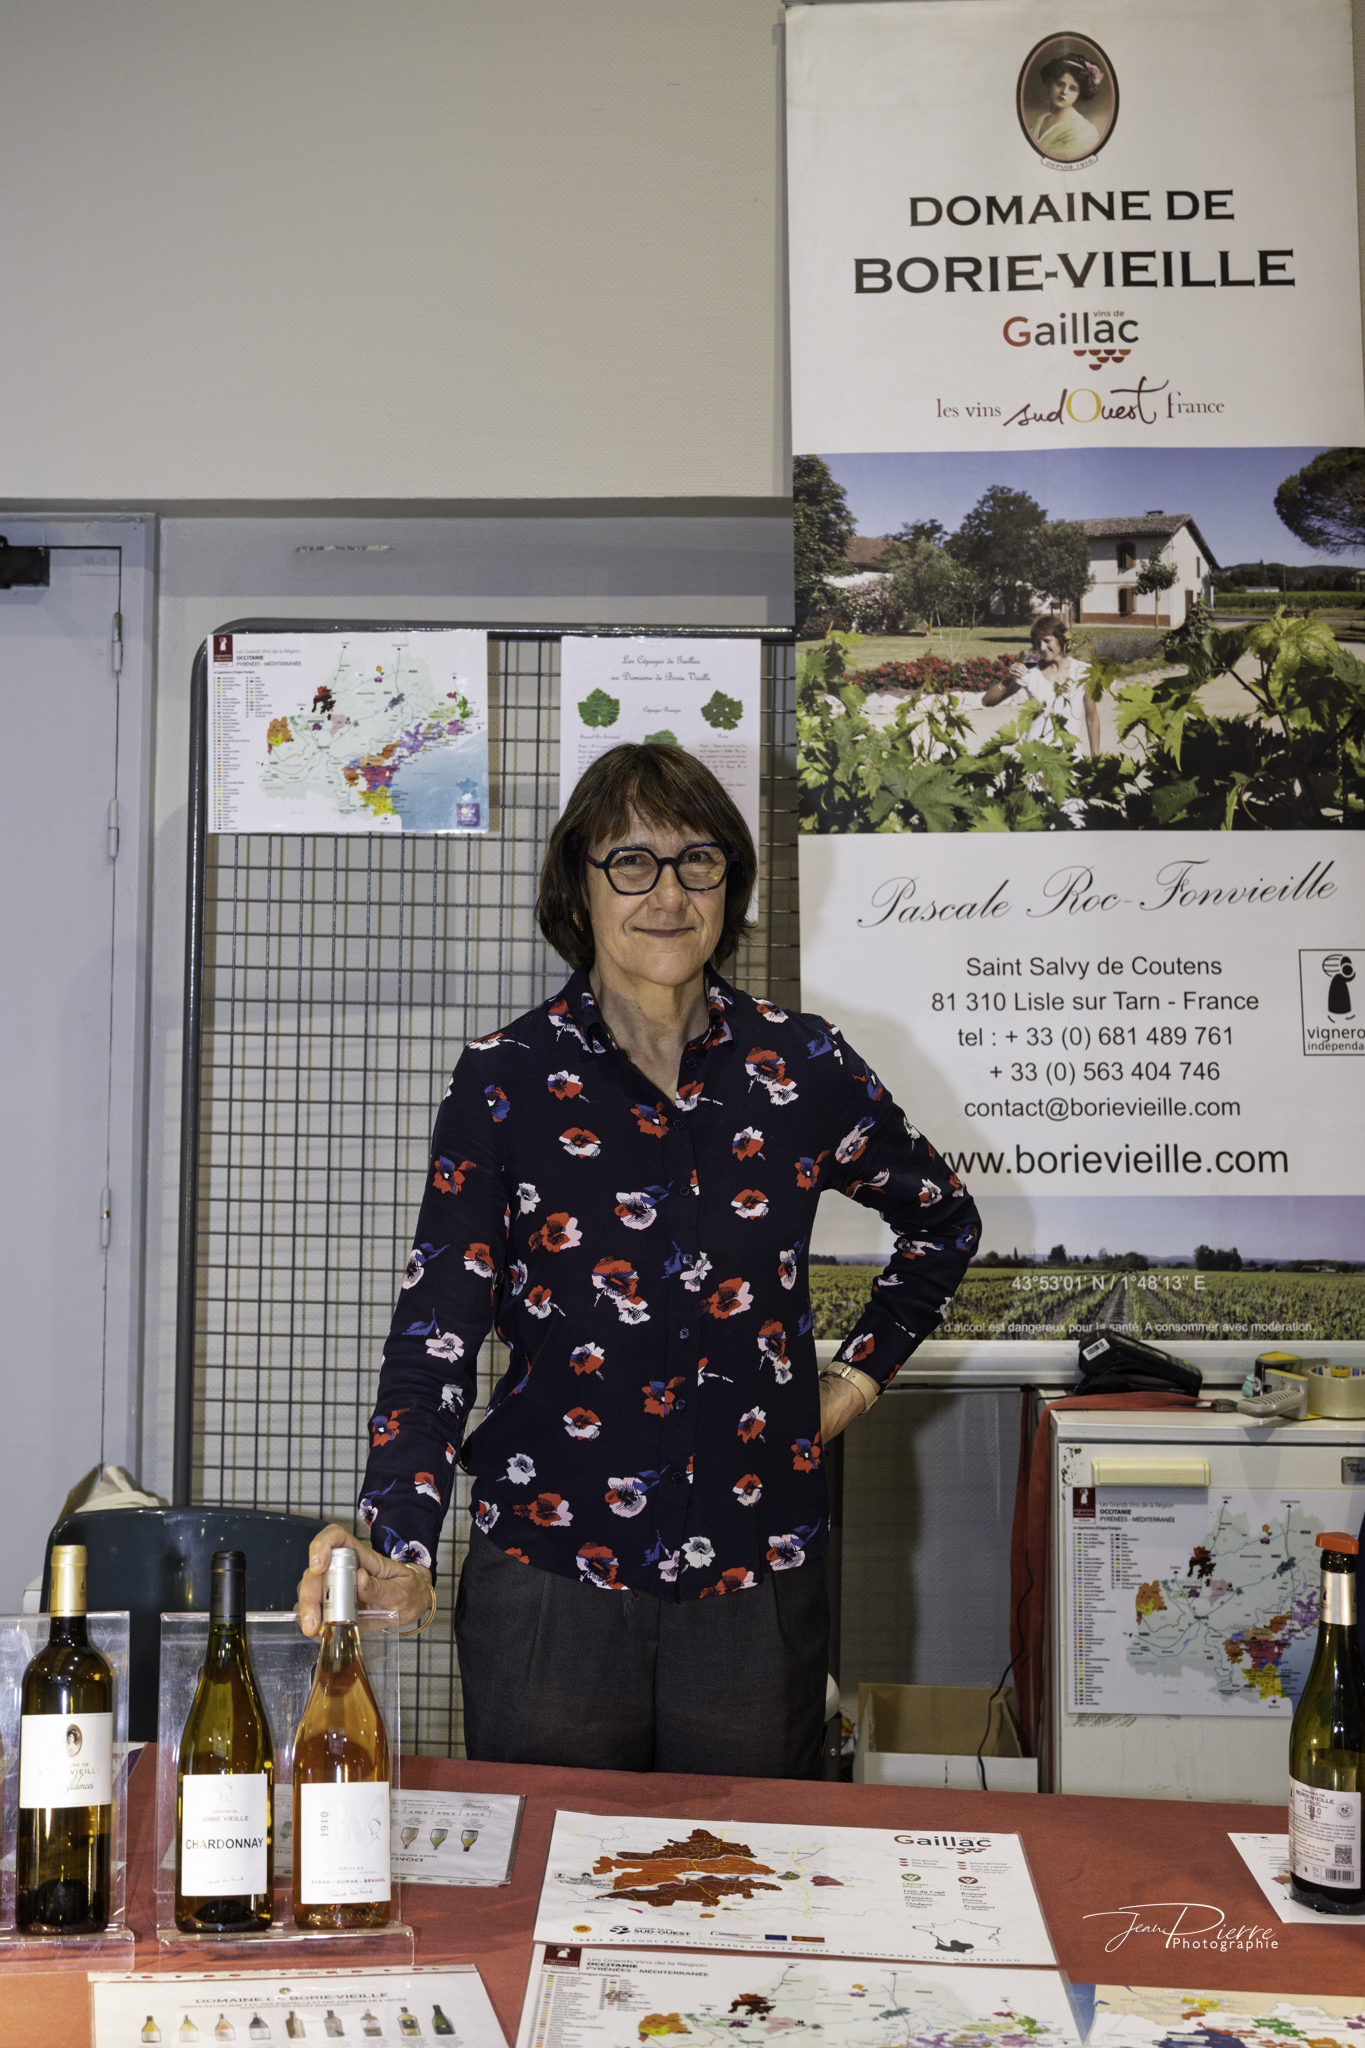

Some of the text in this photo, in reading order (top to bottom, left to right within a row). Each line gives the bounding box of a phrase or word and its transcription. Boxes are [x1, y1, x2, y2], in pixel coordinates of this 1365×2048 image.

[1046, 161, 1073, 170] DEPUIS
[909, 189, 1235, 227] DOMAINE DE
[853, 249, 1296, 294] BORIE-VIEILLE
[1093, 309, 1125, 317] vins de
[1003, 312, 1139, 347] Gaillac
[936, 398, 960, 418] les
[965, 402, 1002, 418] vins
[1166, 390, 1226, 419] france
[622, 655, 634, 664] Les
[637, 655, 664, 667] Cépages
[676, 655, 701, 664] Gaillac
[622, 672, 653, 681] Domaine
[857, 875, 1012, 928] Pascale
[966, 956, 1222, 980] Saint Salvy de Coutens
[931, 993, 957, 1012] 81
[966, 992, 1006, 1012] 310
[1015, 992, 1065, 1011] Lisle
[1072, 996, 1106, 1011] sur
[1113, 992, 1160, 1011] Tarn
[1184, 992, 1259, 1011] France
[958, 1028, 983, 1047] tel
[1005, 1031, 1018, 1043] +
[1026, 1028, 1053, 1046] 33
[1061, 1027, 1091, 1050] (0)
[1099, 1027, 1136, 1045] 681
[1147, 1027, 1187, 1045] 489
[1195, 1027, 1233, 1045] 761
[1307, 1026, 1365, 1042] vignero
[990, 1062, 1220, 1085] + 33 (0) 563 404 746
[964, 1097, 1240, 1121] contact@borievieille.com
[942, 1143, 1288, 1174] ww.borievieille.com
[1092, 1276, 1105, 1291] N
[1109, 1276, 1115, 1291] /
[1195, 1276, 1206, 1291] E
[988, 1323, 1005, 1333] est
[1008, 1322, 1066, 1336] dangereux
[1068, 1324, 1093, 1336] pour
[1145, 1323, 1154, 1332] A
[1156, 1324, 1219, 1333] consommer
[1222, 1324, 1248, 1333] avec
[320, 1811, 329, 1837] 1910
[186, 1838, 263, 1849] CHARDONNAY
[894, 1835, 992, 1847] Gaillac
